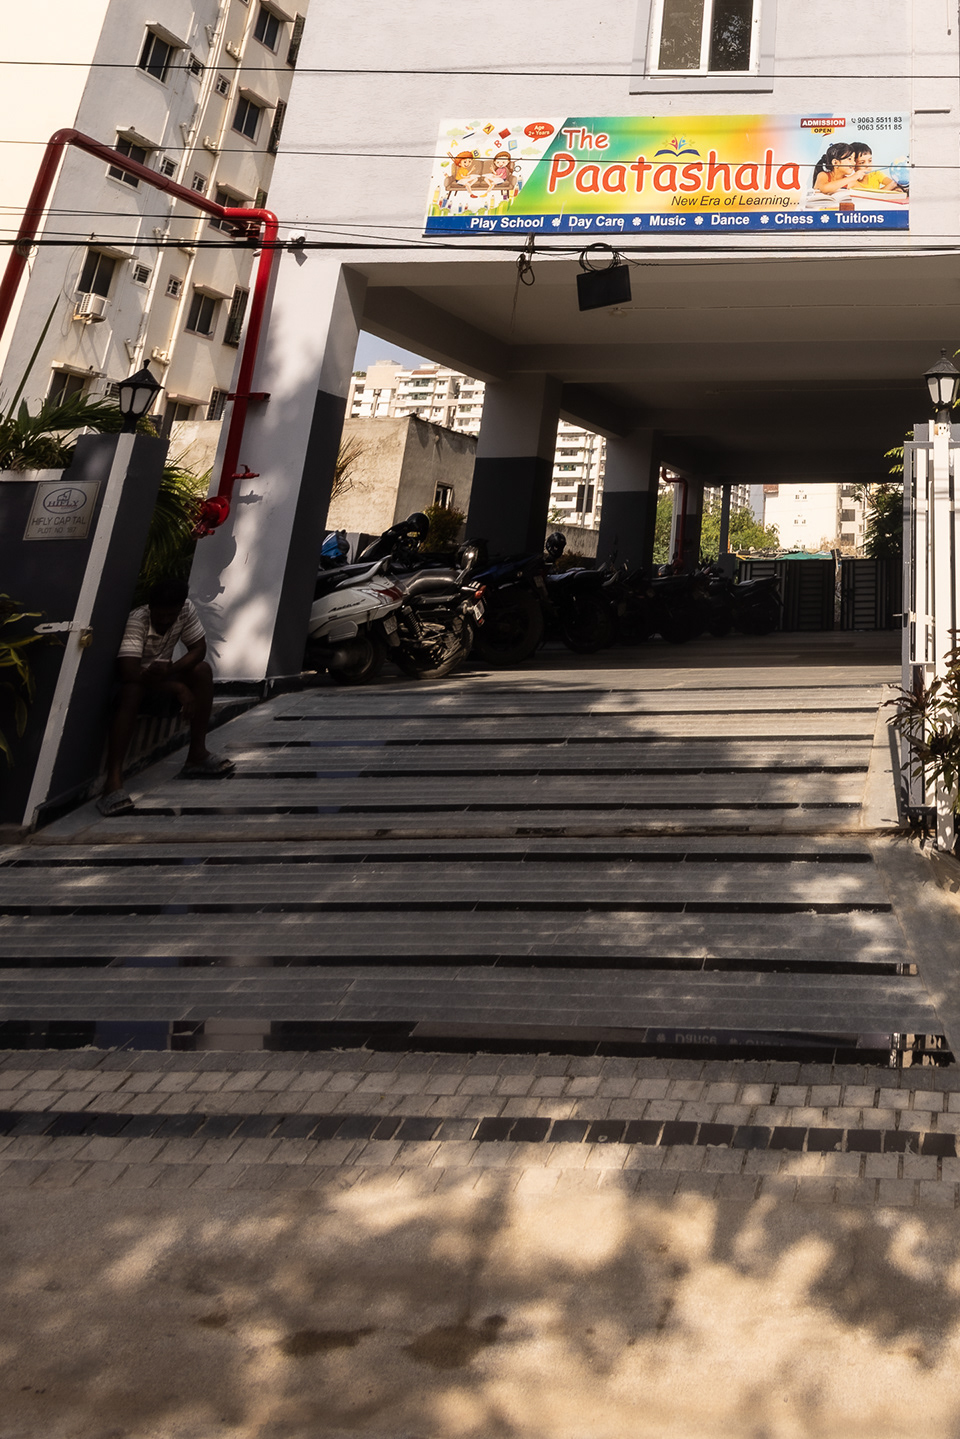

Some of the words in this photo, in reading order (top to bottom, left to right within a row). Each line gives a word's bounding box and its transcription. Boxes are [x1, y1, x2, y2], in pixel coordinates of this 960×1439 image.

[802, 119, 845, 127] ADMISSION
[563, 127, 609, 149] The
[547, 149, 801, 193] Paatashala
[671, 196, 698, 206] New
[700, 195, 720, 206] Era
[724, 195, 737, 205] of
[470, 217, 498, 230] Play
[500, 216, 544, 228] School
[568, 216, 593, 229] Day
[595, 215, 625, 227] Care
[649, 215, 687, 226] Music
[711, 213, 750, 225] Dance
[774, 213, 814, 224] Chess
[834, 213, 885, 224] Tuitions
[31, 517, 53, 526] HIFLY
[54, 515, 86, 526] CAPTAL
